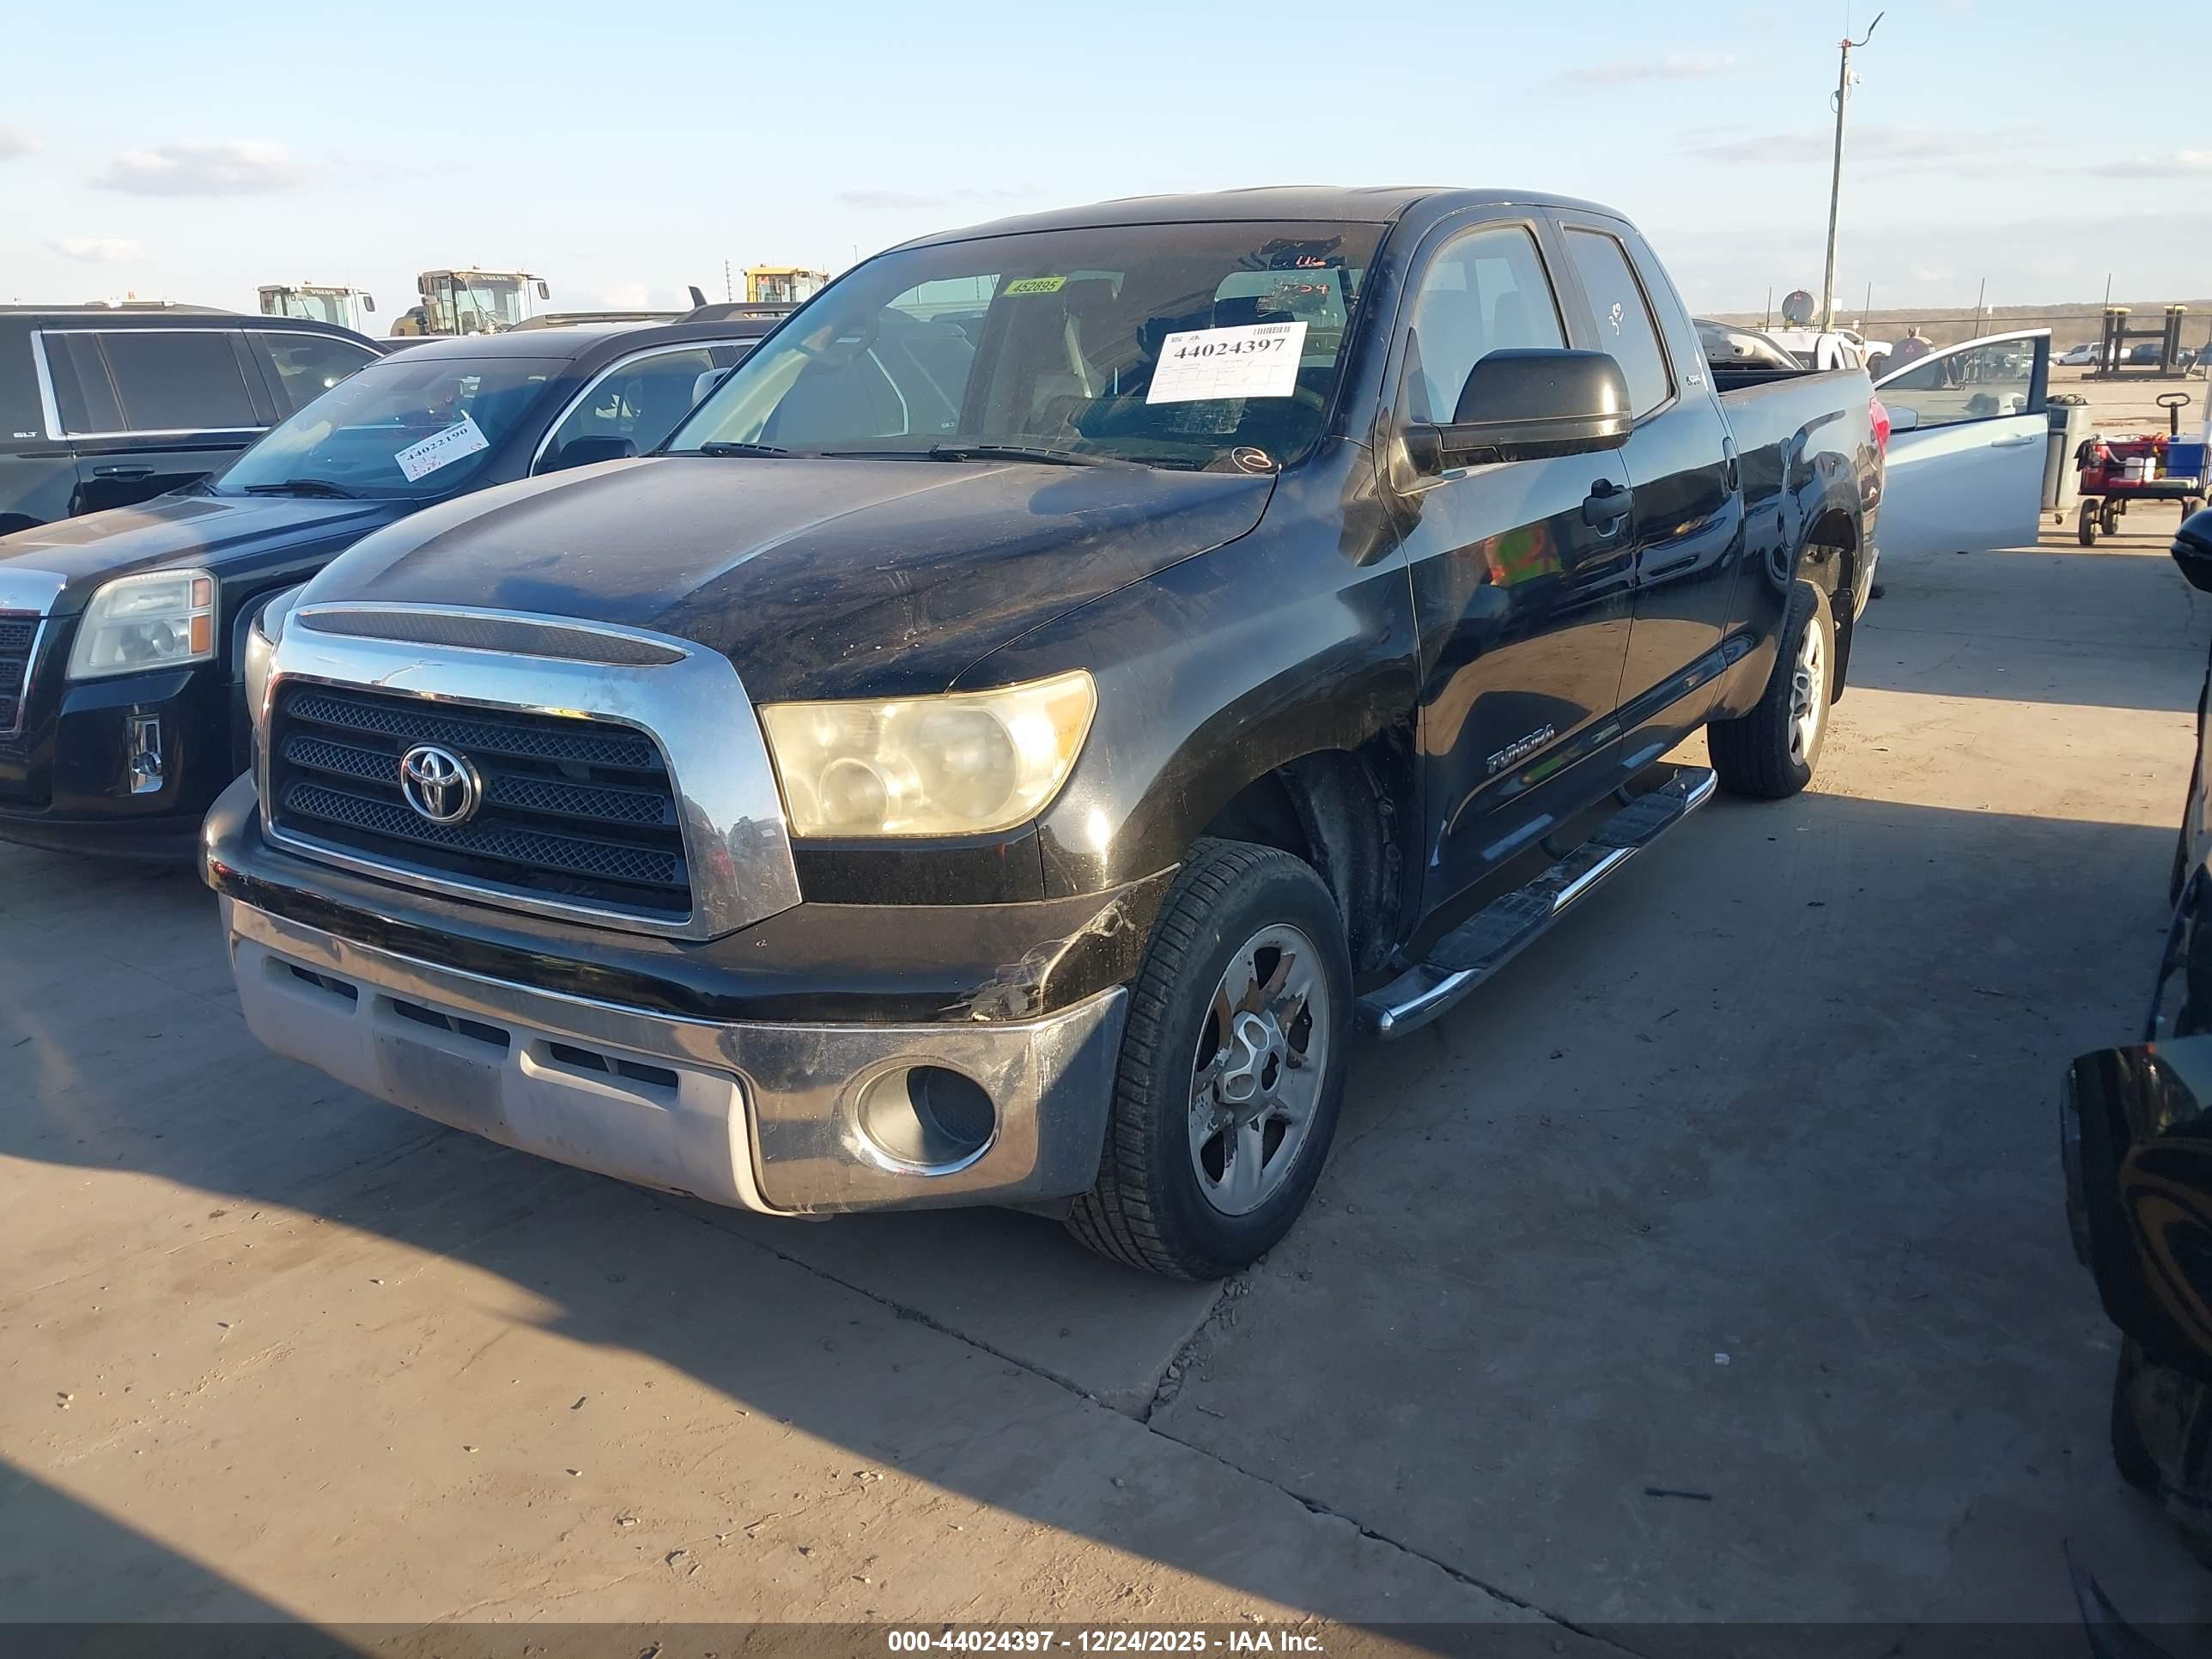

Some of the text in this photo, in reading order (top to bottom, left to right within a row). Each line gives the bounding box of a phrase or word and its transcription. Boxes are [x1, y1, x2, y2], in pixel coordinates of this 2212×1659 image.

[1012, 280, 1060, 293] 452895
[1174, 337, 1286, 360] 44024397
[406, 428, 468, 461] 44022190
[1486, 723, 1556, 774] TUNDRA
